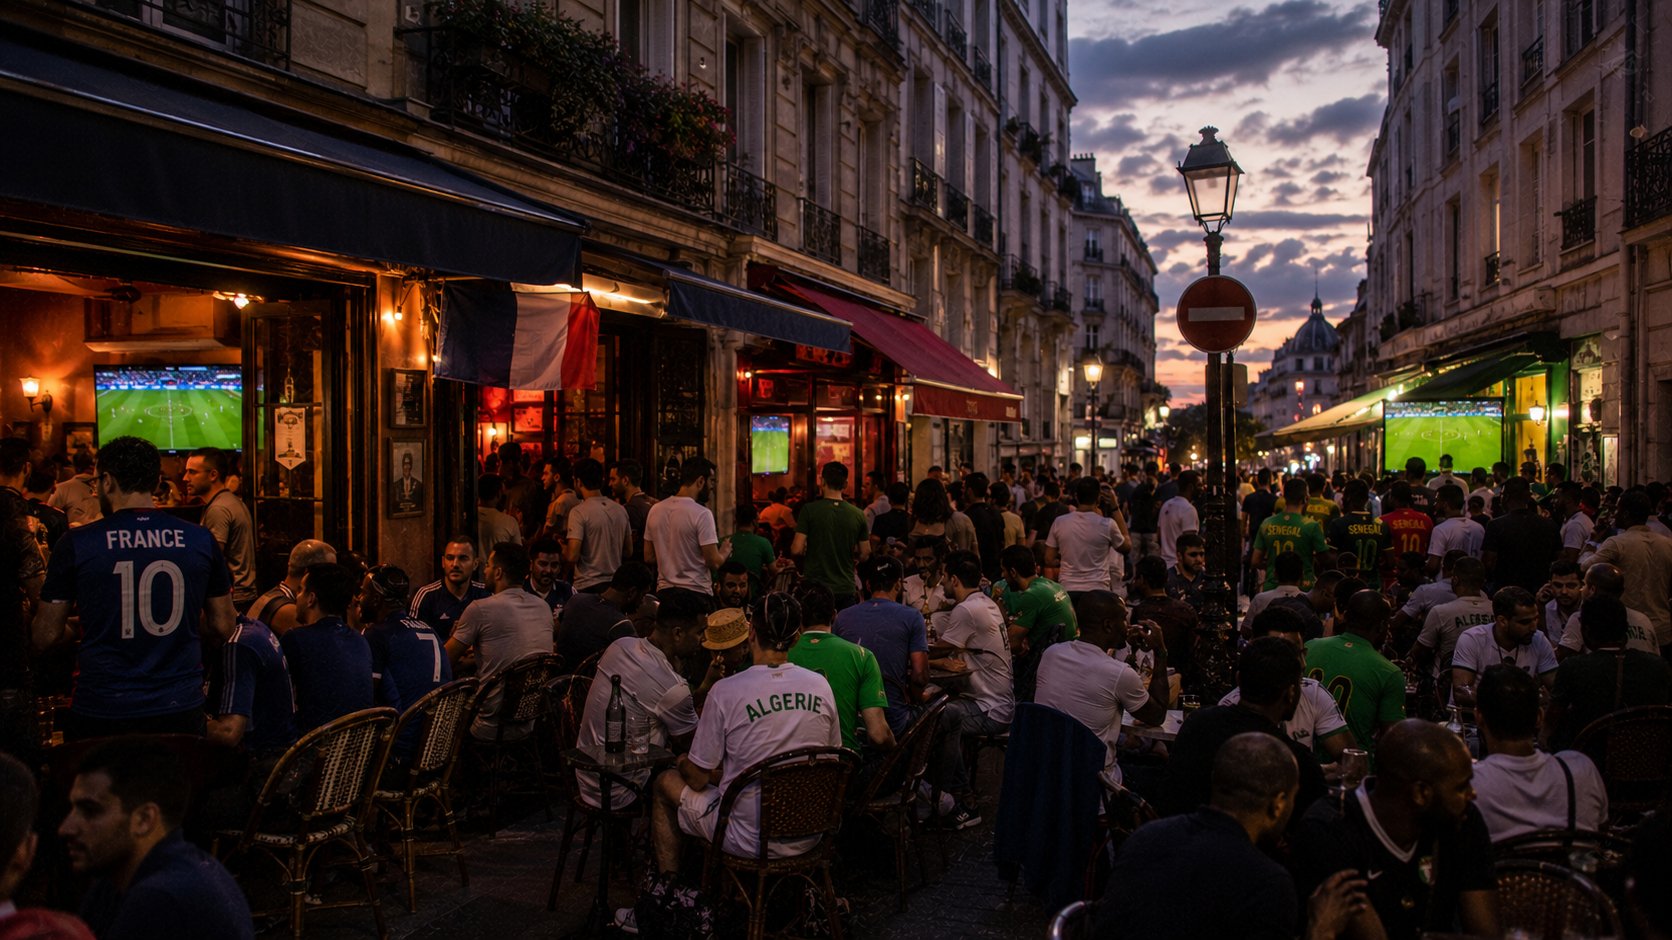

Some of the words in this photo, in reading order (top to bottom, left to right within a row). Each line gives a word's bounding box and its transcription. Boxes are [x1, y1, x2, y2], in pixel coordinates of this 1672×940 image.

[106, 529, 186, 550] FRANCE
[1267, 525, 1302, 538] SENEGAL
[1348, 523, 1383, 536] SENEGAL
[1356, 539, 1378, 571] 10
[112, 559, 186, 640] 10
[415, 632, 442, 683] 7
[746, 692, 823, 723] ALGERIE
[1308, 667, 1353, 718] 0
